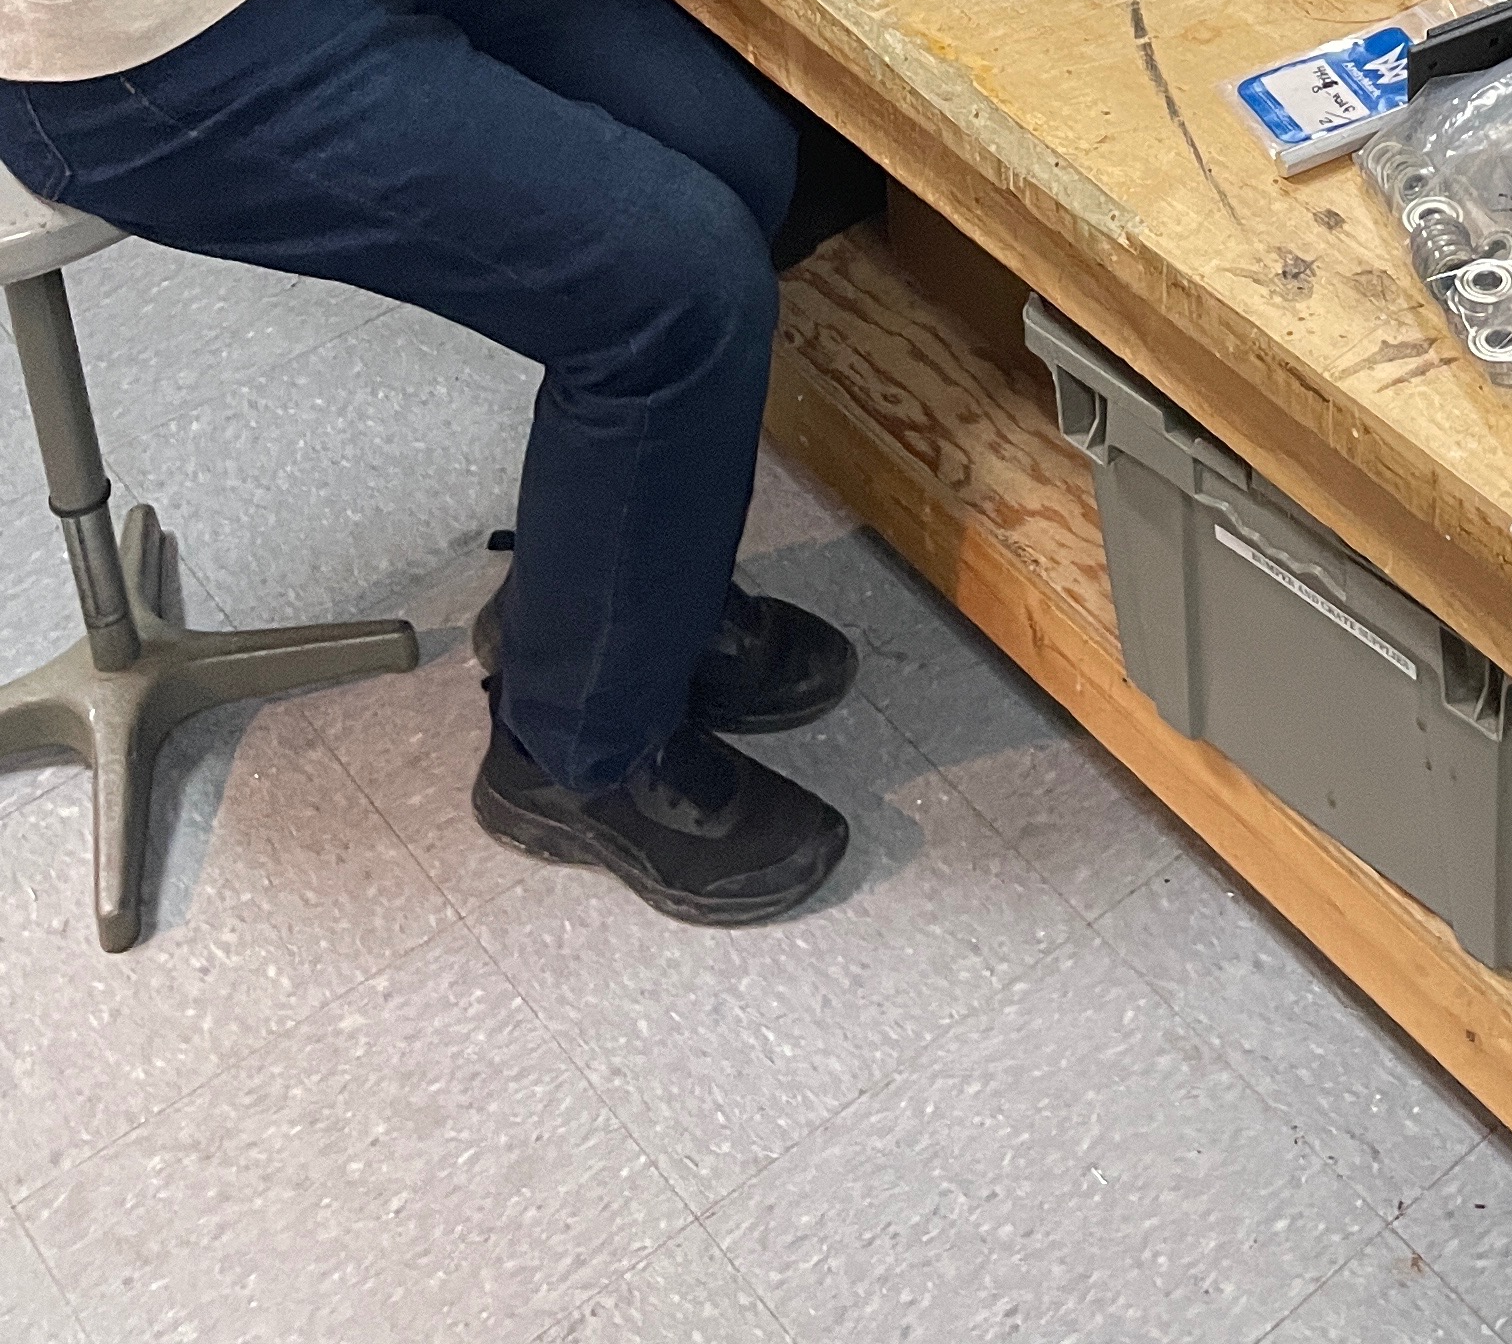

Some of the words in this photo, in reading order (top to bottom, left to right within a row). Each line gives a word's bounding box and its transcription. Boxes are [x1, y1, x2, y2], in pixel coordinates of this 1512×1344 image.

[1342, 61, 1382, 101] AndyMark
[1298, 583, 1320, 606] AND
[1319, 600, 1357, 632] CRATE
